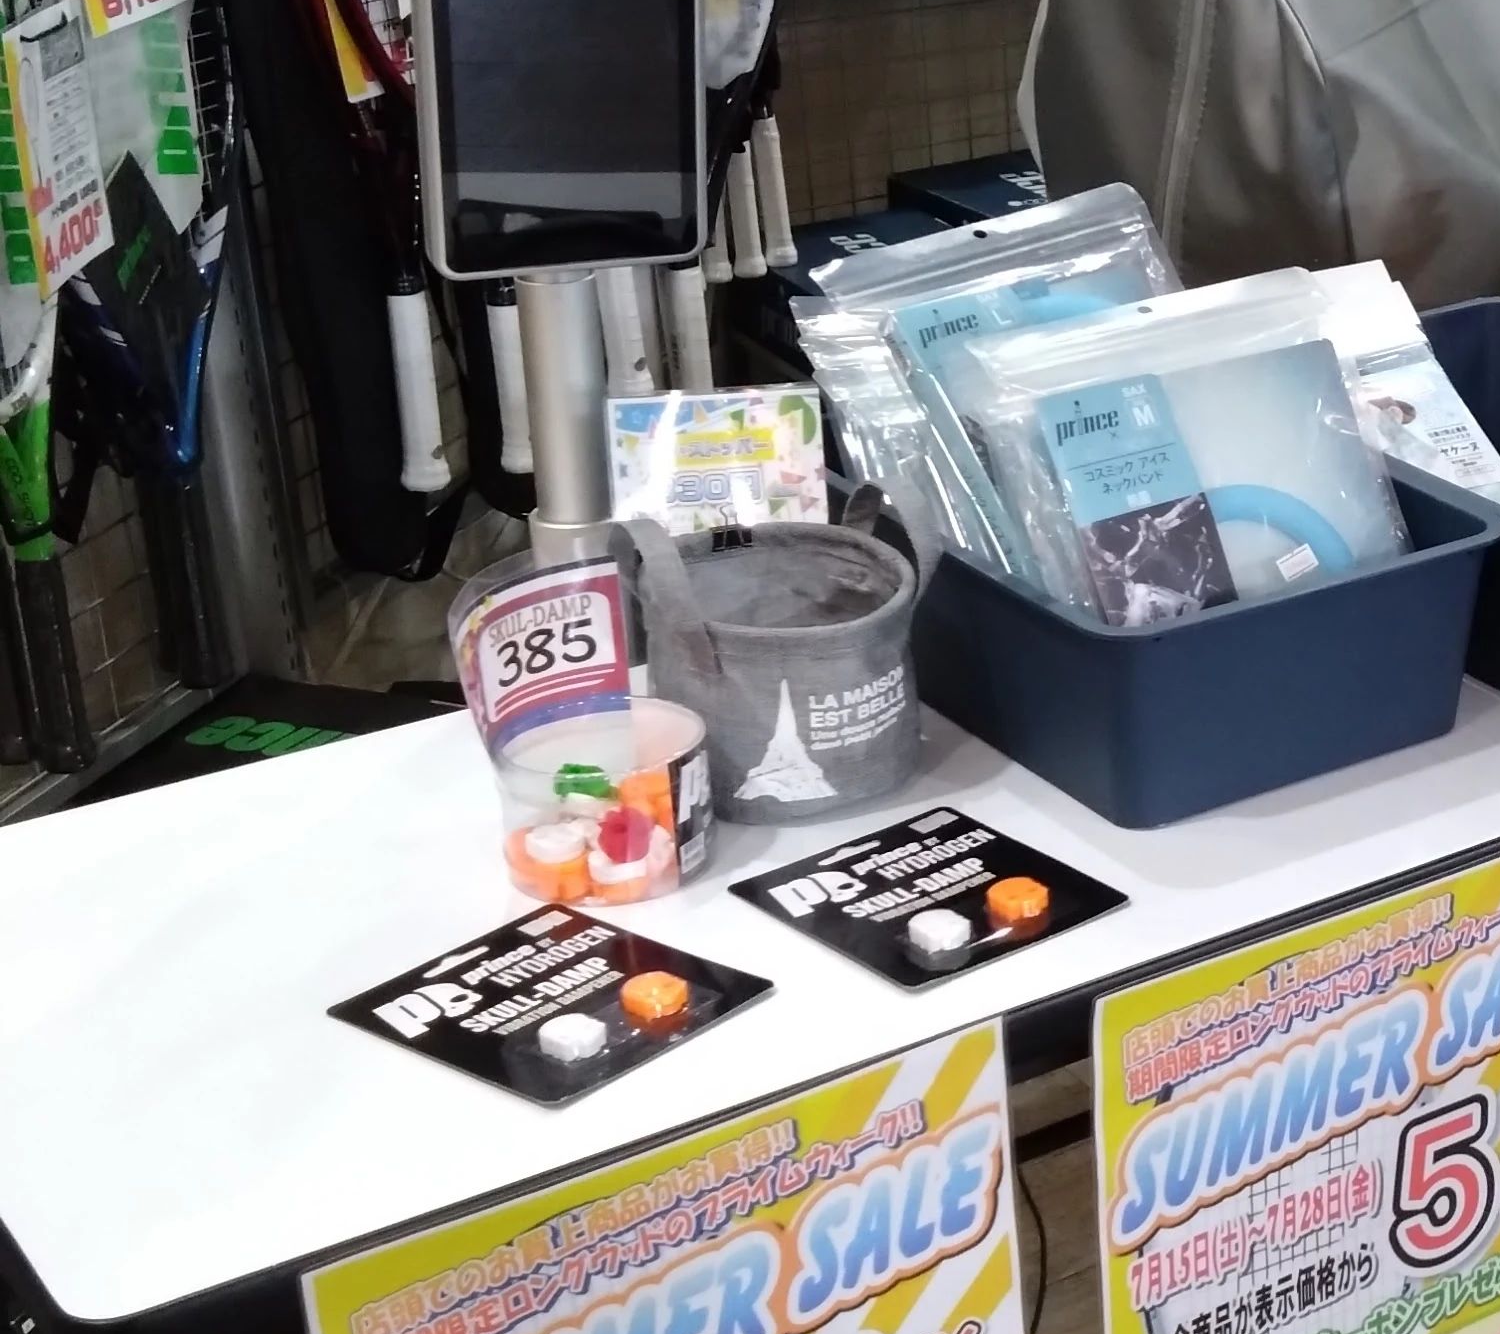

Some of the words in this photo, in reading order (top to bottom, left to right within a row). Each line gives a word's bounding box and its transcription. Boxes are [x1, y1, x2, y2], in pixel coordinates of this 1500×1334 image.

[1132, 403, 1156, 428] M
[497, 618, 598, 688] 385
[808, 693, 839, 709] LA
[810, 708, 852, 728] EST
[857, 682, 905, 720] BELLE
[850, 841, 923, 875] prince
[876, 828, 998, 881] HYDROGEN
[842, 857, 984, 918] SKULL-DAMP
[460, 944, 536, 986] prince
[489, 925, 617, 988] HYDROGEN
[459, 956, 611, 1034] SKULL-DAMP
[1121, 996, 1422, 1235] SUMMER
[1389, 1093, 1495, 1269] 5
[798, 1120, 1000, 1312] SALE
